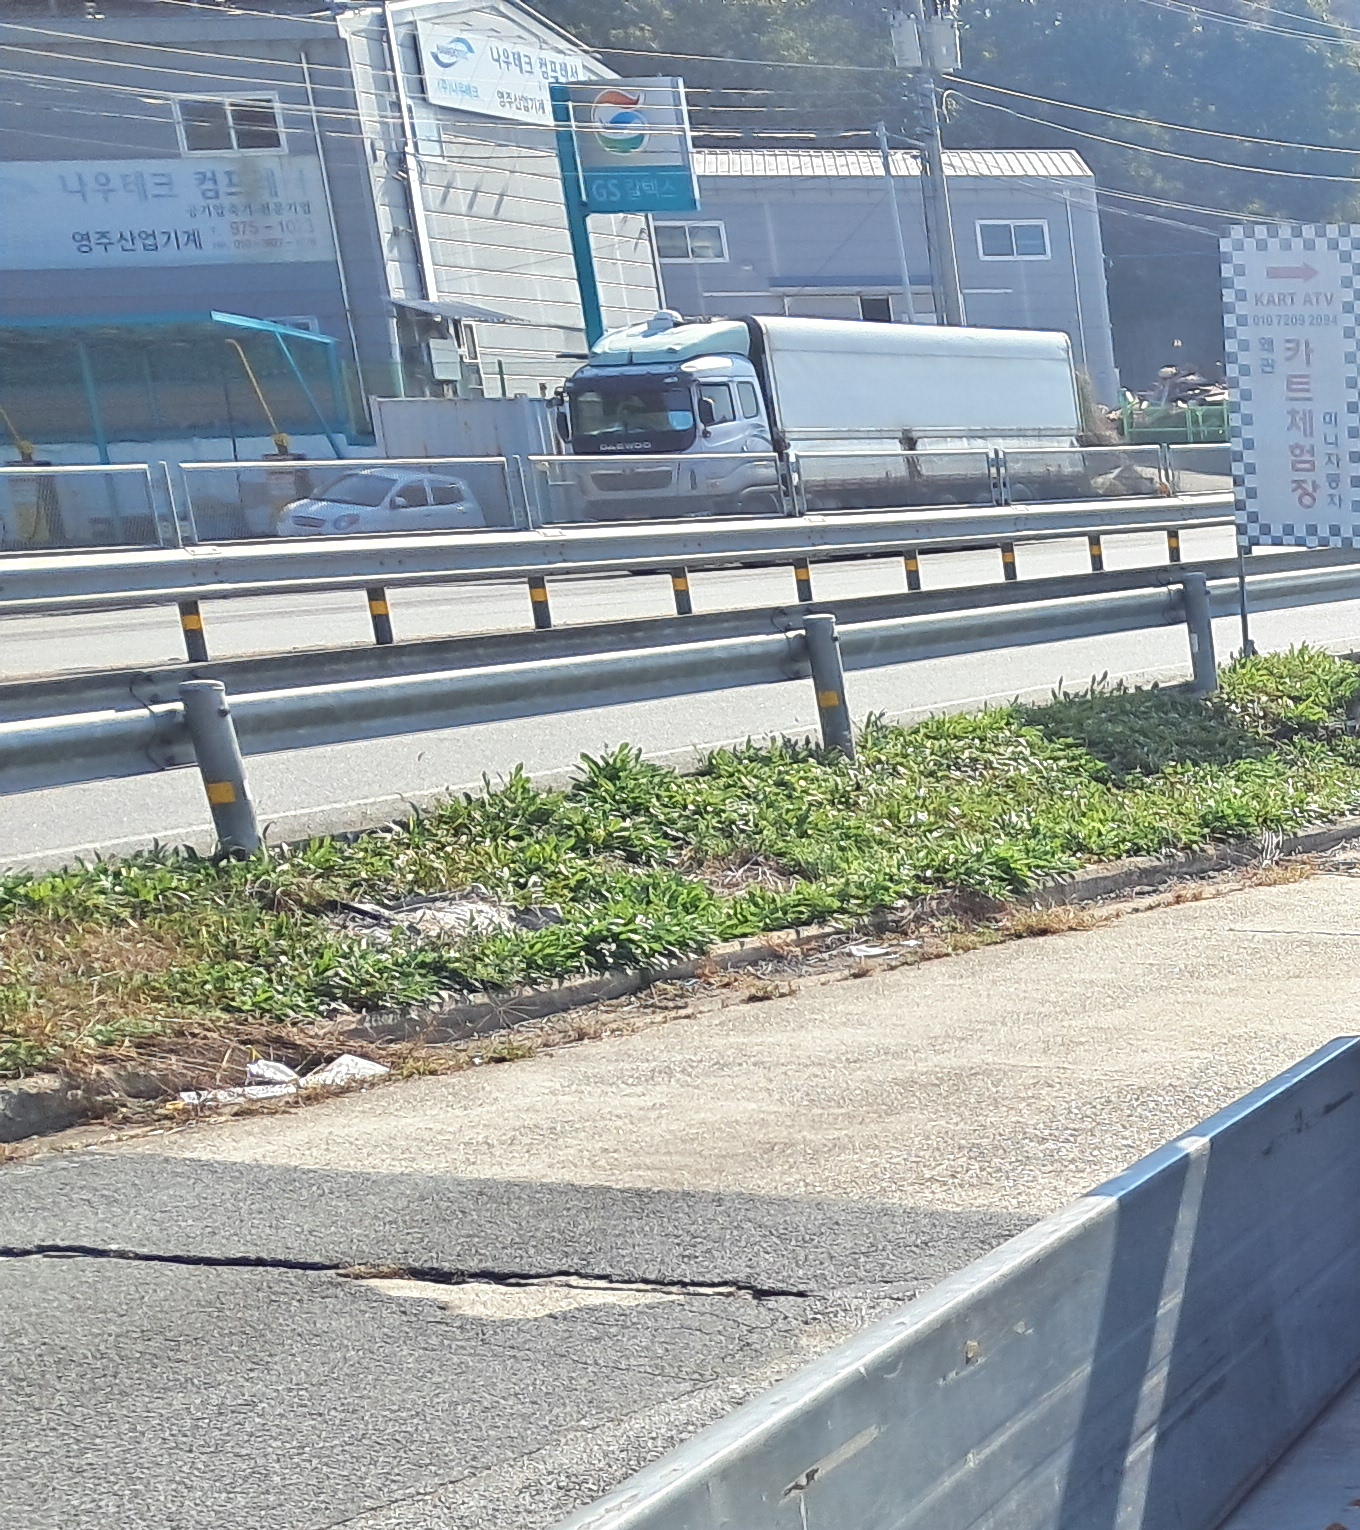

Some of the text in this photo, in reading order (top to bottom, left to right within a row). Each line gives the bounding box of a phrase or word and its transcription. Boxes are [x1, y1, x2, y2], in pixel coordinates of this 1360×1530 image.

[490, 45, 533, 75] 나우테크
[497, 89, 546, 115] 영주산업기계
[59, 169, 179, 202] 나우테크
[592, 178, 677, 202] GS 칼텍스
[71, 228, 203, 254] 영주산업기계
[1254, 291, 1334, 306] KART ATV
[1252, 314, 1273, 327] 010
[1284, 338, 1320, 510] 카트체험장
[600, 441, 651, 451] DAEWOO
